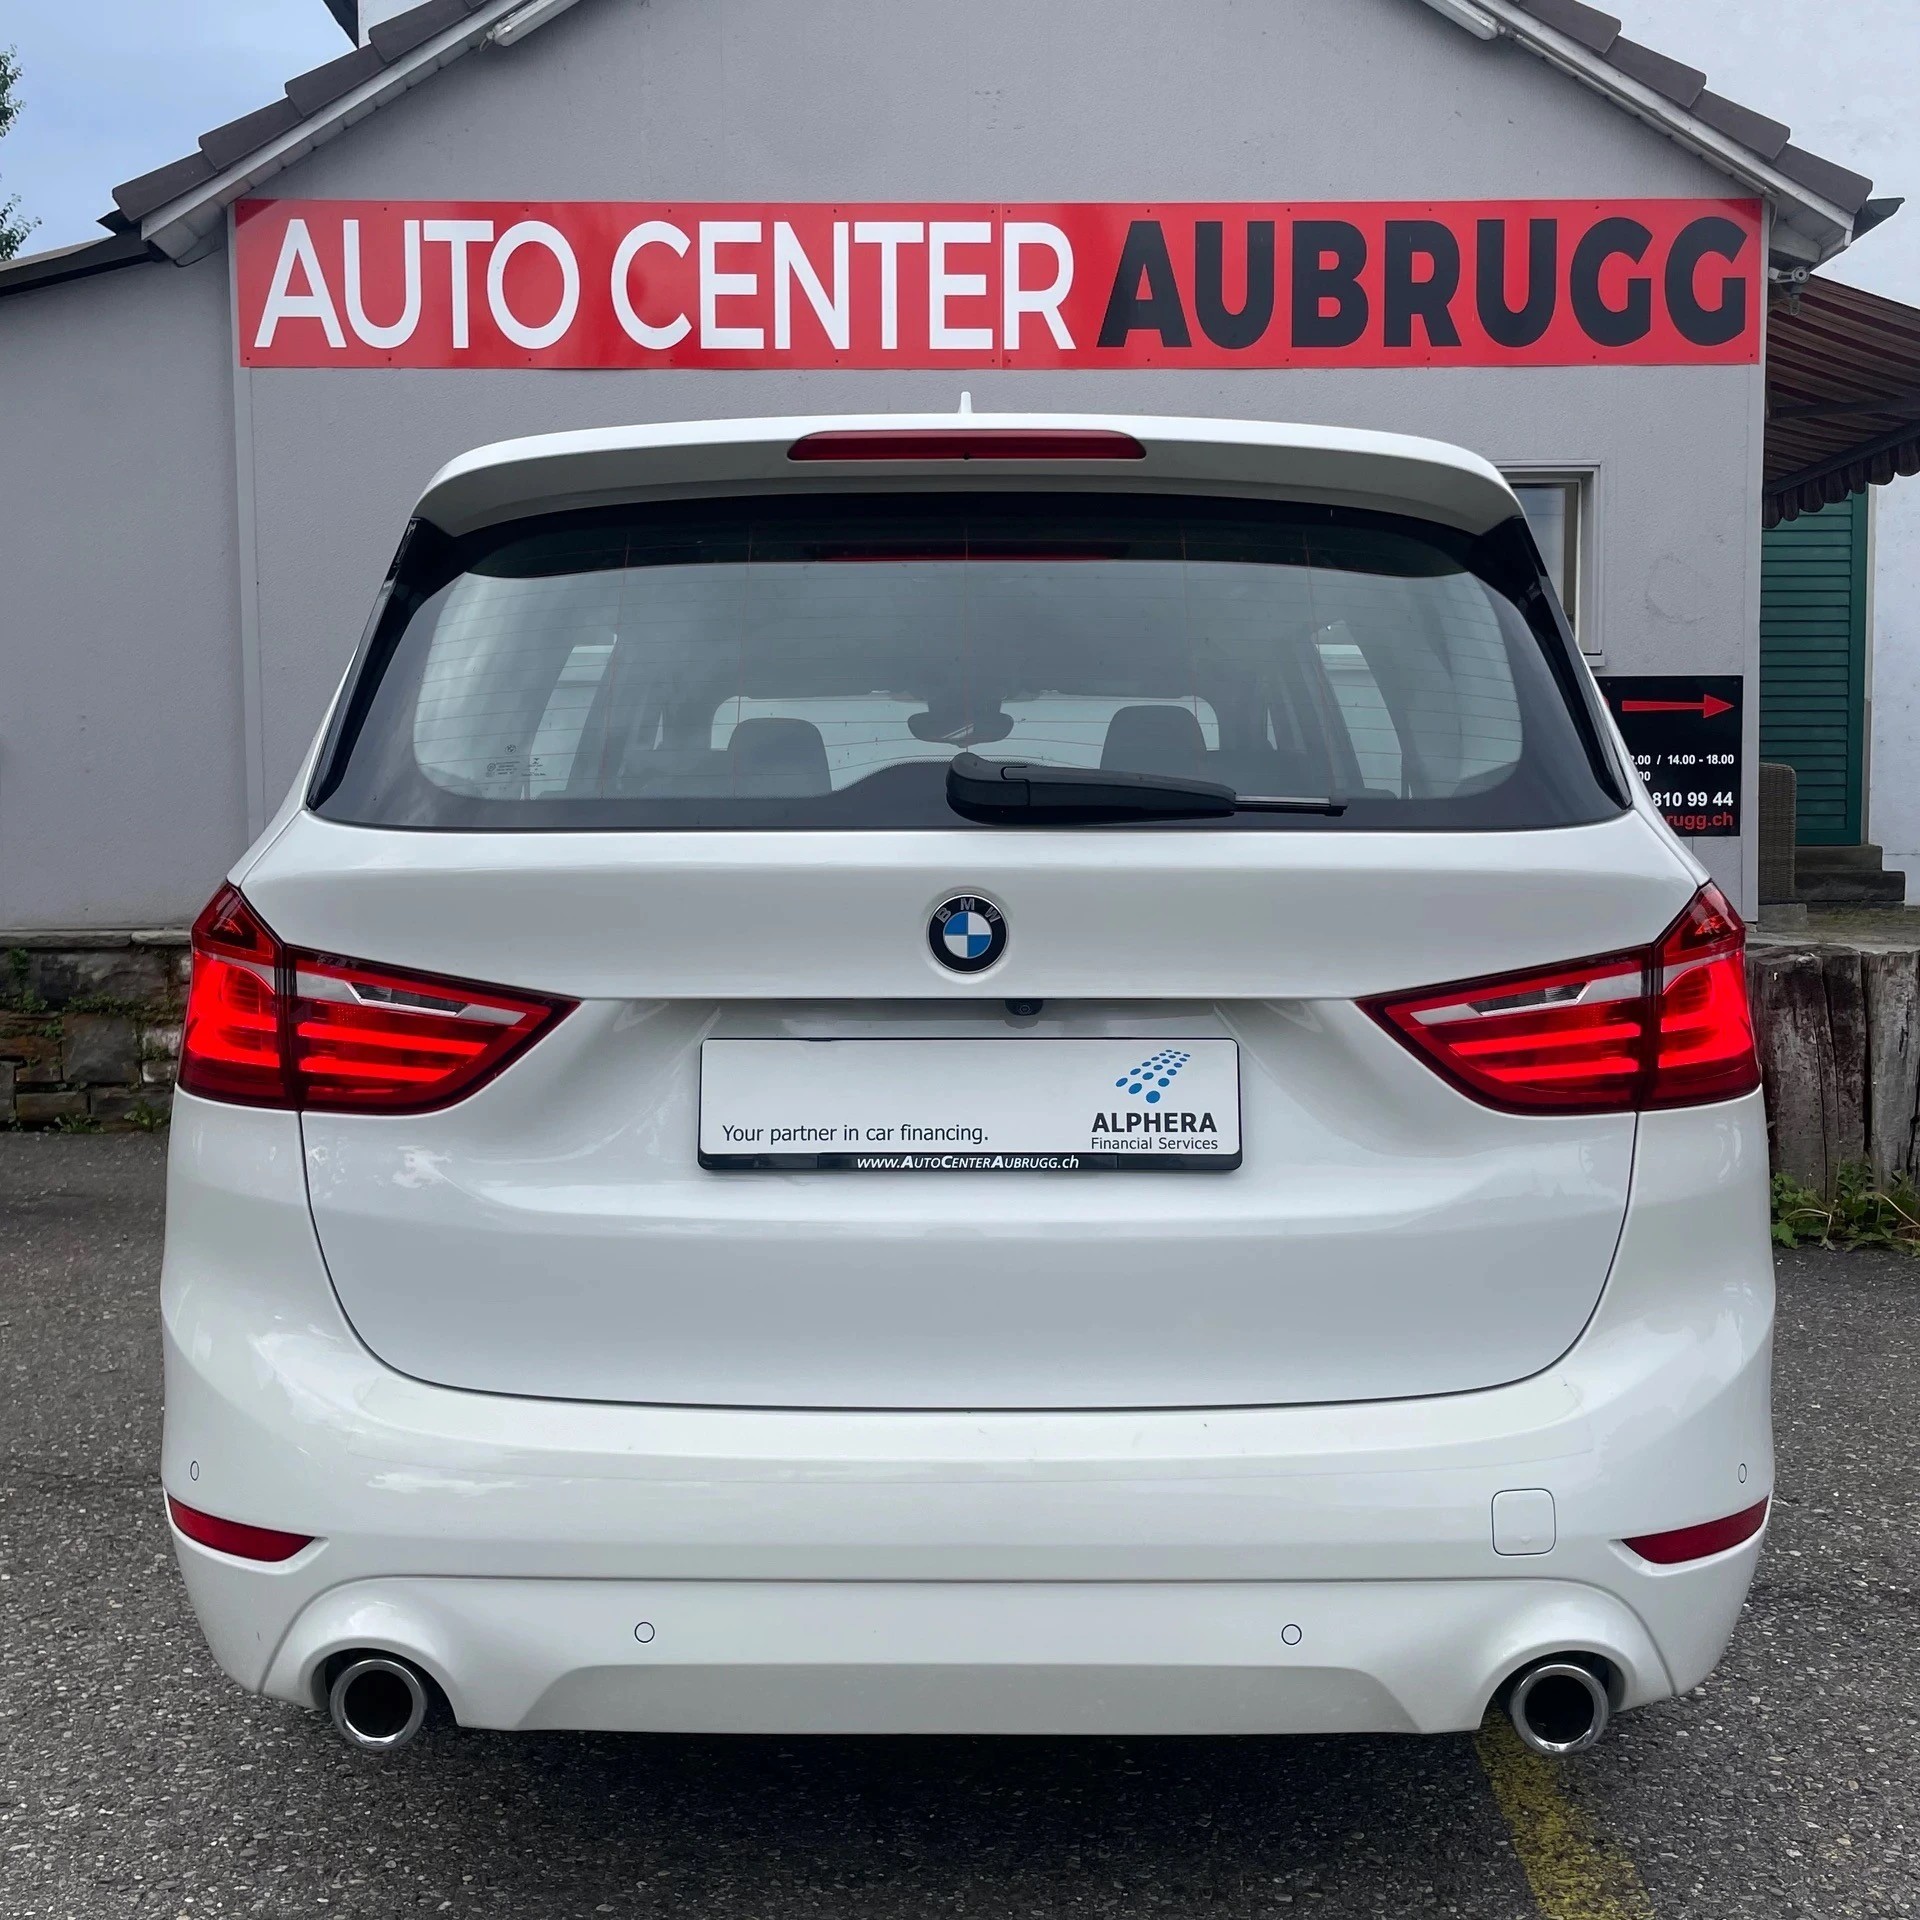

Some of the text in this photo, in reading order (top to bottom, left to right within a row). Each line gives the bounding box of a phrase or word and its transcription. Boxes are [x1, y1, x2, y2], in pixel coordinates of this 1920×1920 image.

[254, 216, 1749, 351] AUTO CENTER AUBRUGG
[1667, 754, 1696, 765] 14.00
[1706, 754, 1735, 765] 18.00
[1652, 791, 1734, 807] 810 99 44
[935, 897, 1001, 924] BMW
[1091, 1112, 1218, 1133] ALPHERA
[722, 1124, 989, 1145] Your partner in car financing.
[1091, 1137, 1219, 1150] Financial Services
